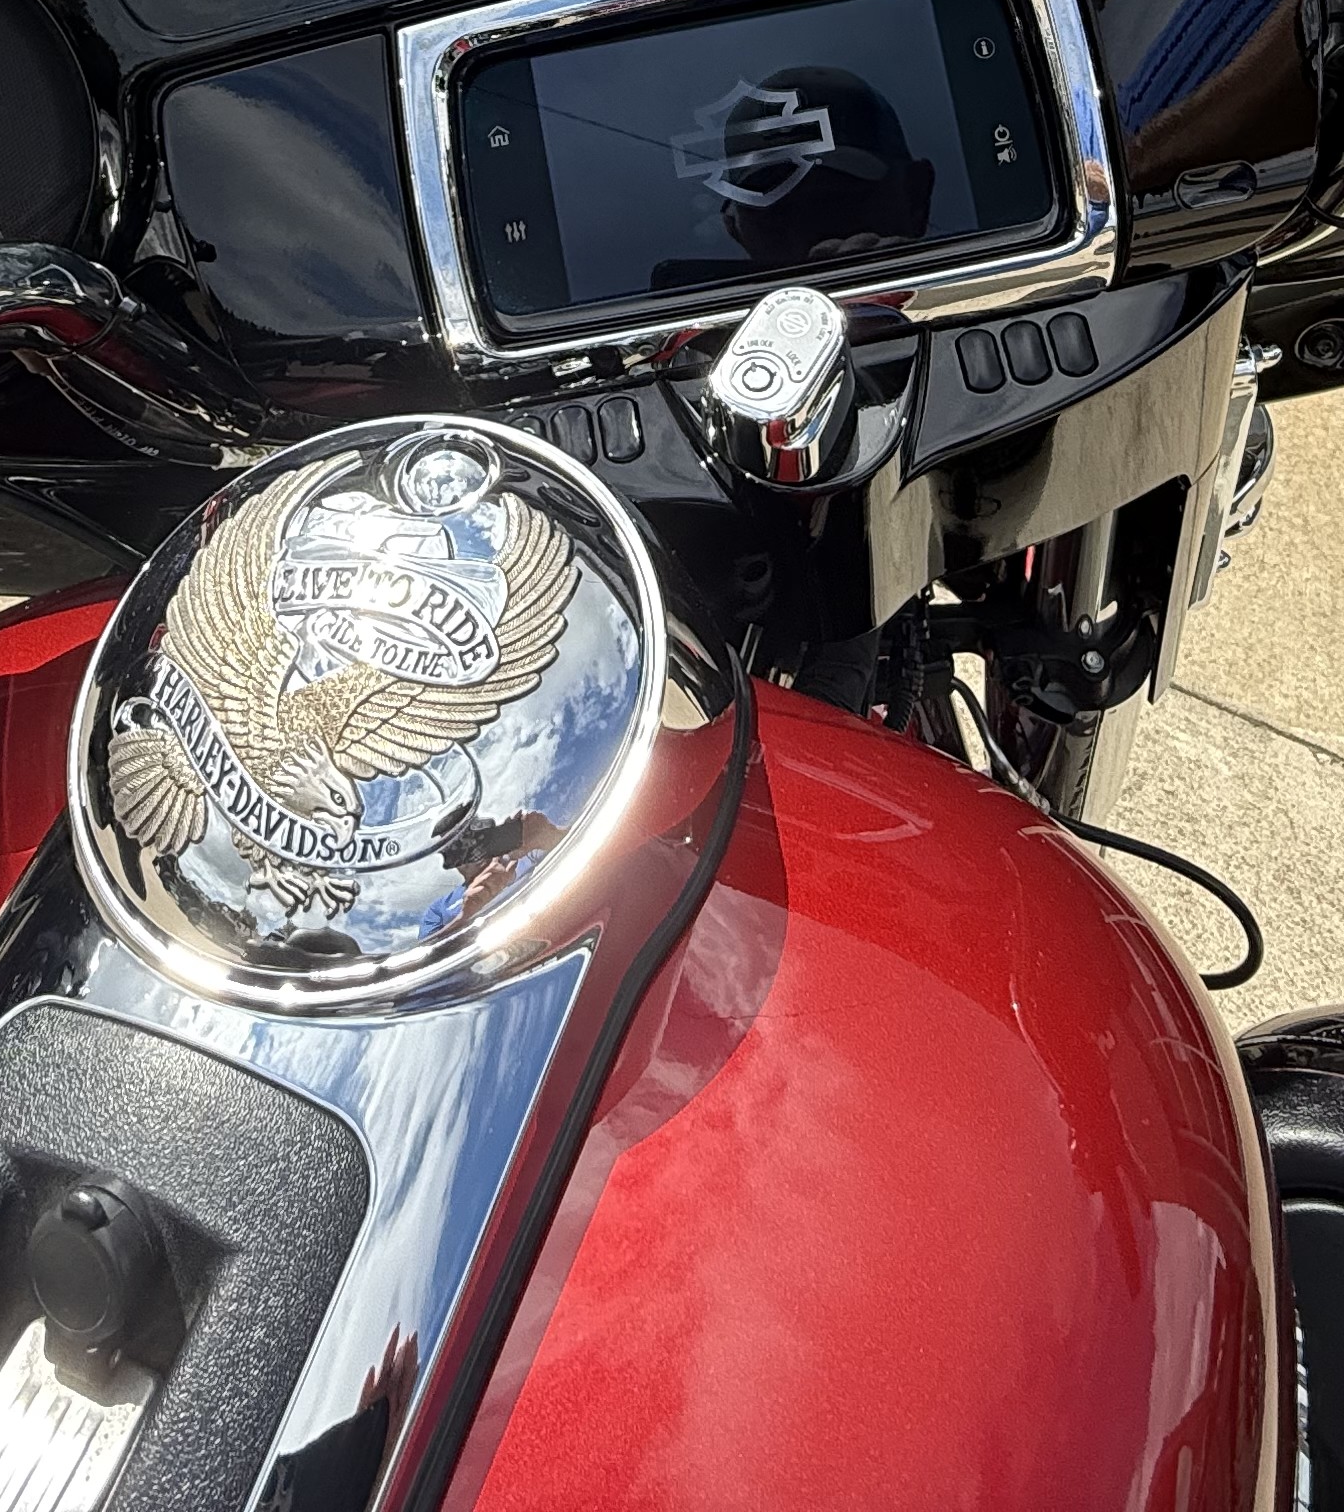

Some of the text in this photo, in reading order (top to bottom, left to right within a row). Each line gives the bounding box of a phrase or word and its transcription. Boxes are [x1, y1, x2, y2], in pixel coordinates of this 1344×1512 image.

[747, 340, 774, 348] UNLOCK
[785, 350, 802, 366] LOCK
[274, 566, 359, 603] LIVE
[412, 583, 494, 671] RIDE
[371, 638, 398, 666] TO
[395, 646, 452, 679] LIVE
